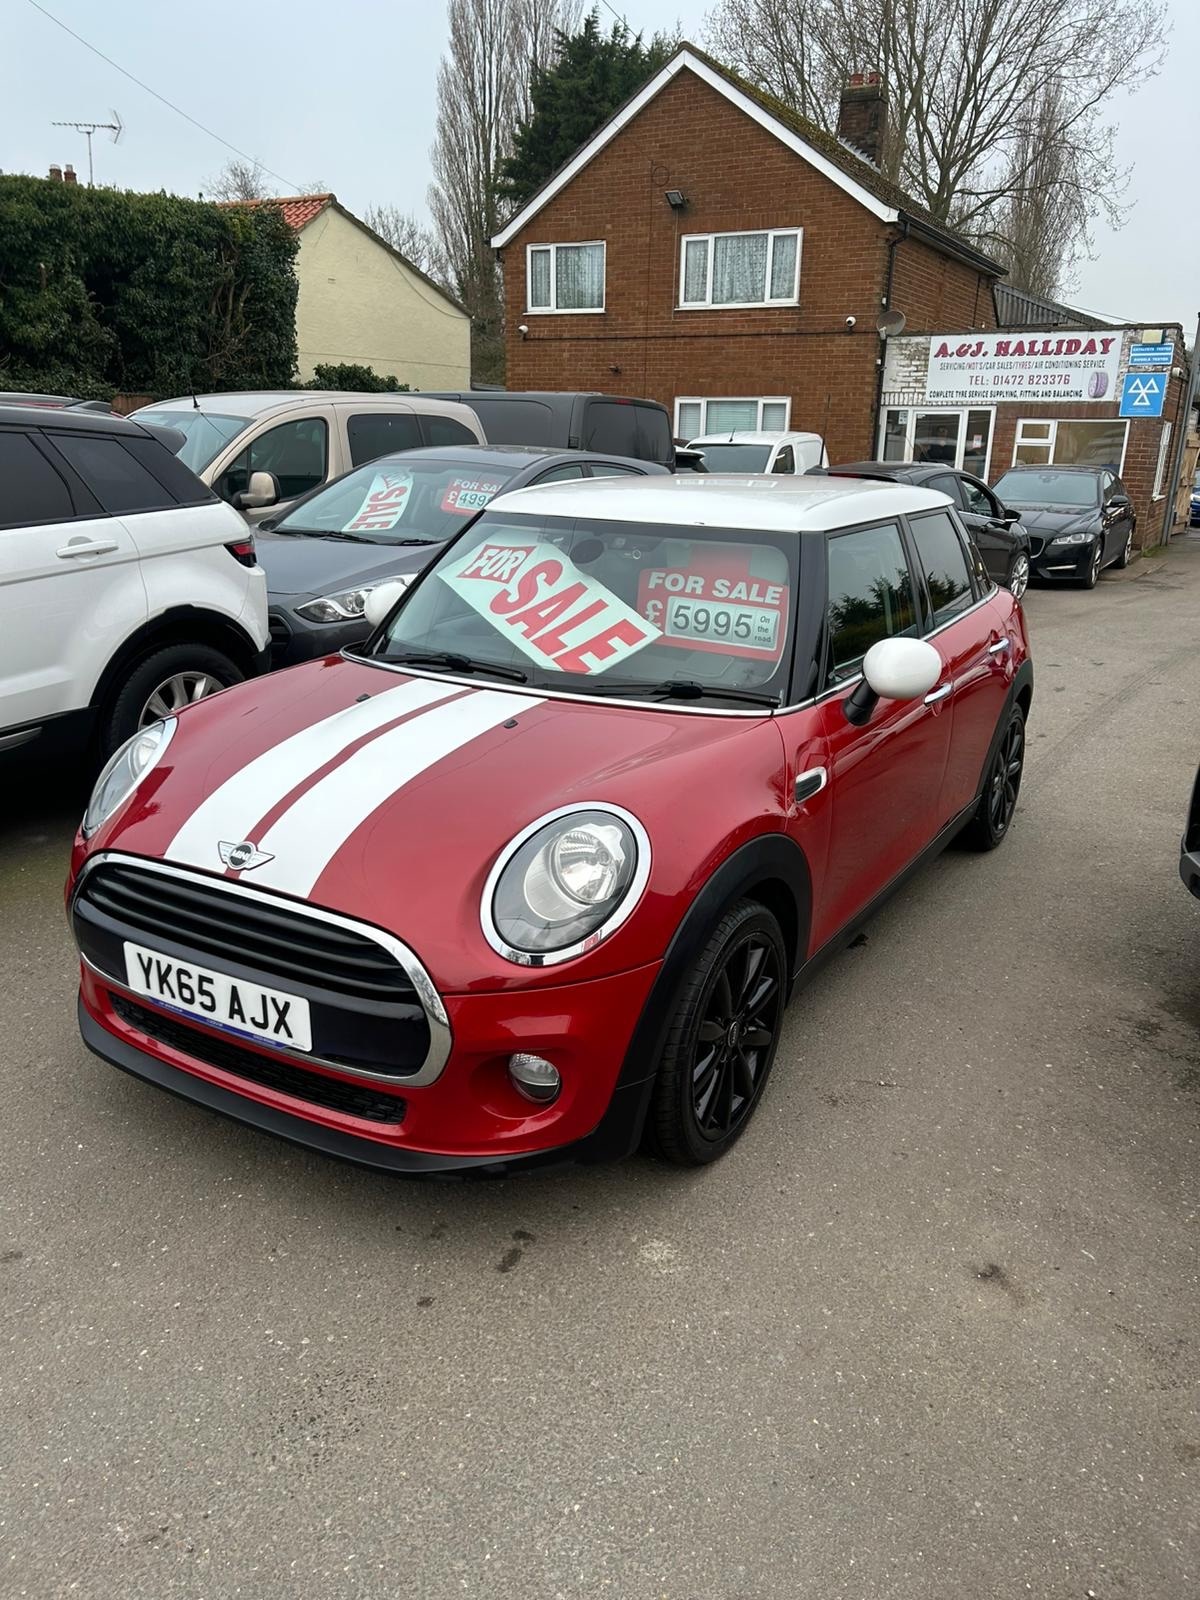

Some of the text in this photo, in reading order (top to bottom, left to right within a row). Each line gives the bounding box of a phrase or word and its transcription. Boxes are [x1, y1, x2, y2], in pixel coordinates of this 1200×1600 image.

[994, 337, 1116, 357] HALLIDAY
[1082, 359, 1106, 369] SERVICE
[969, 374, 1071, 386] TEL: 01472 823376
[929, 390, 954, 398] COMPLETE
[955, 390, 967, 398] TYRE
[968, 390, 990, 398] SERVICE
[1020, 390, 1040, 398] FITTING
[1040, 390, 1052, 398] AND
[1052, 389, 1083, 398] BALANCING
[453, 478, 502, 493] FOR SA
[459, 492, 491, 507] 499
[348, 486, 408, 529] SALE
[464, 547, 527, 581] FOR
[648, 571, 783, 605] FOR SALE
[490, 559, 648, 674] SALE
[672, 604, 753, 639] 5995
[759, 615, 771, 624] On
[757, 625, 769, 634] the
[231, 848, 251, 862] MINI
[137, 952, 294, 1039] YK65 AJX
